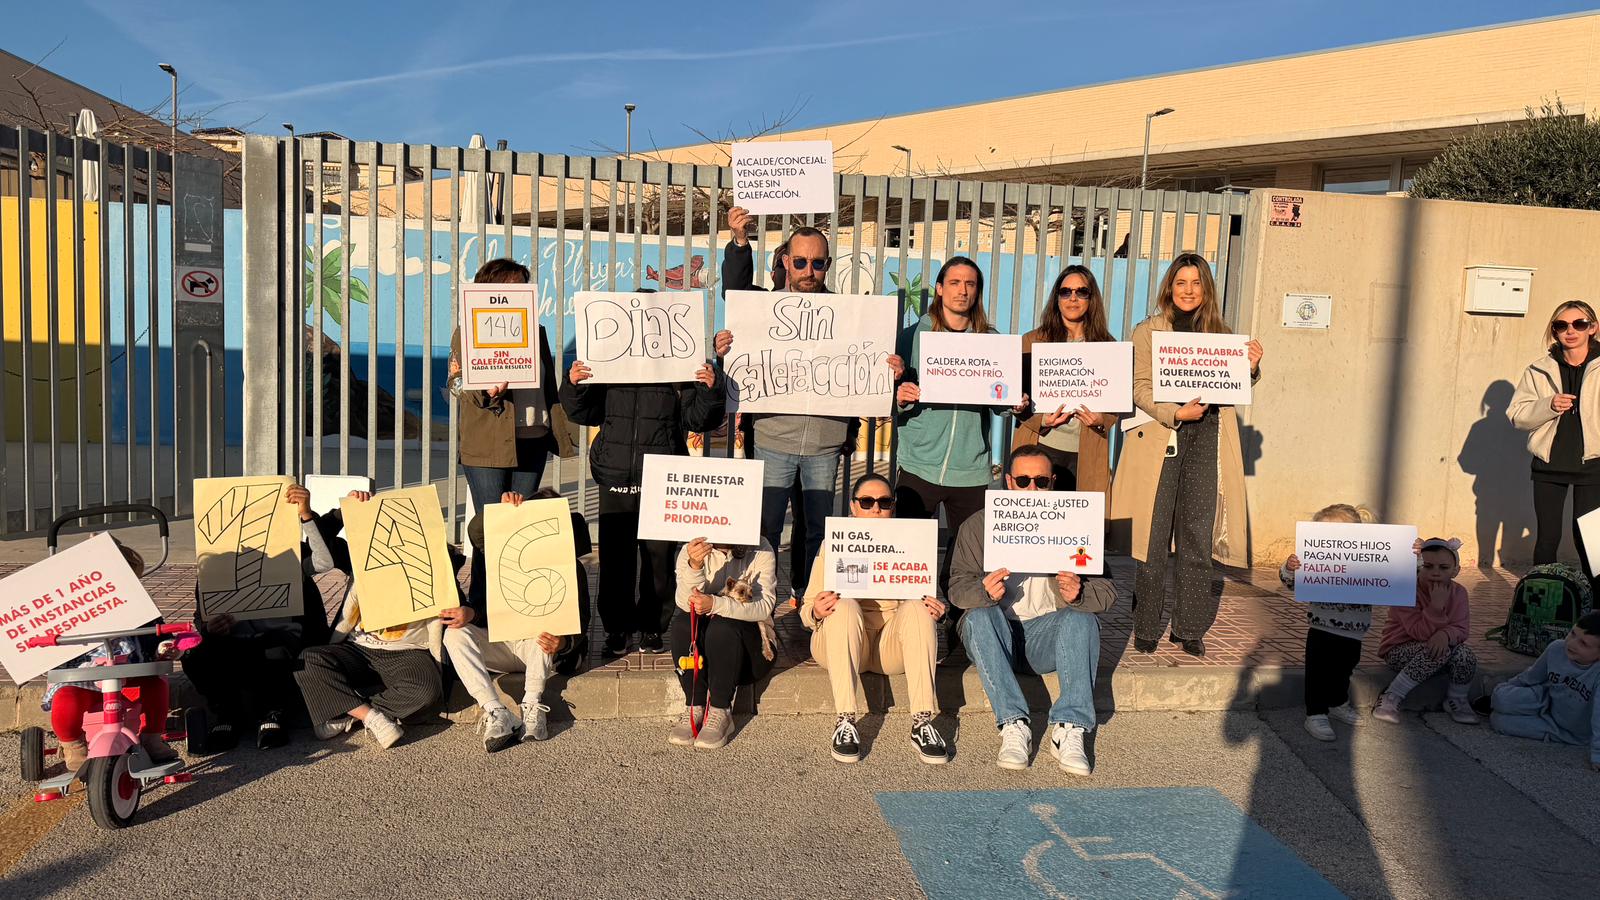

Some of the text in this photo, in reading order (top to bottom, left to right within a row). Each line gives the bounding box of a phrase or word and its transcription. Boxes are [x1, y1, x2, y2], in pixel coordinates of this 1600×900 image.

[736, 156, 827, 166] ALCALDE/CONCEJAL:
[736, 168, 806, 177] VENGA USTED A
[737, 179, 780, 188] CLASE SIN
[737, 189, 801, 199] CALEFACCIÓN.
[489, 293, 509, 304] DÍA
[768, 295, 834, 341] Sin
[484, 315, 520, 337] 146
[584, 297, 696, 362] Dias
[1159, 346, 1244, 356] MENOS PALABRAS
[471, 356, 532, 366] CALEFACCIÓN
[926, 356, 966, 366] CALDERA
[968, 358, 991, 366] ROTA
[1039, 358, 1082, 366] EXIGIMOS
[1168, 356, 1188, 366] MÁS
[1191, 357, 1228, 367] ACCIÓN
[926, 367, 1004, 378] NIÑOS CON FRÍO.
[1039, 367, 1095, 376] REPARACIÓN
[1159, 368, 1230, 378] ¡QUEREMOS YA
[1039, 378, 1108, 389] INMEDIATA. ¡NO
[1160, 379, 1241, 390] LA CALEFACCIÓN!
[1039, 389, 1102, 398] MÁS EXCUSAS!
[667, 473, 745, 486] EL BIENESTAR
[666, 486, 720, 498] INFANTIL
[665, 500, 708, 511] ES UNA
[993, 497, 1089, 510] CONCEJAL: ¿USTED
[664, 513, 731, 526] PRIORIDAD.
[993, 510, 1066, 520] TRABAJA CON
[992, 523, 1039, 532] ABRIGO?
[832, 531, 873, 541] NI GAS,
[992, 534, 1091, 546] NUESTROS HIJOS SÍ.
[198, 483, 290, 615] 1
[831, 544, 905, 554] NI CALDERA...
[1304, 539, 1391, 551] NUESTROS HIJOS
[364, 497, 435, 612] 4
[1303, 551, 1389, 563] PAGAN VUESTRA
[498, 517, 567, 617] 6
[873, 561, 928, 571] ¡SE ACABA
[1303, 563, 1347, 573] FALTA DE
[873, 575, 931, 584] LA ESPERA!
[1303, 576, 1391, 588] MANTENIMINTO.
[0, 570, 103, 627] MÁS DE 1 AÑO
[5, 581, 116, 640] DE INSTANCIAS
[43, 596, 128, 638] RESPUESTA.
